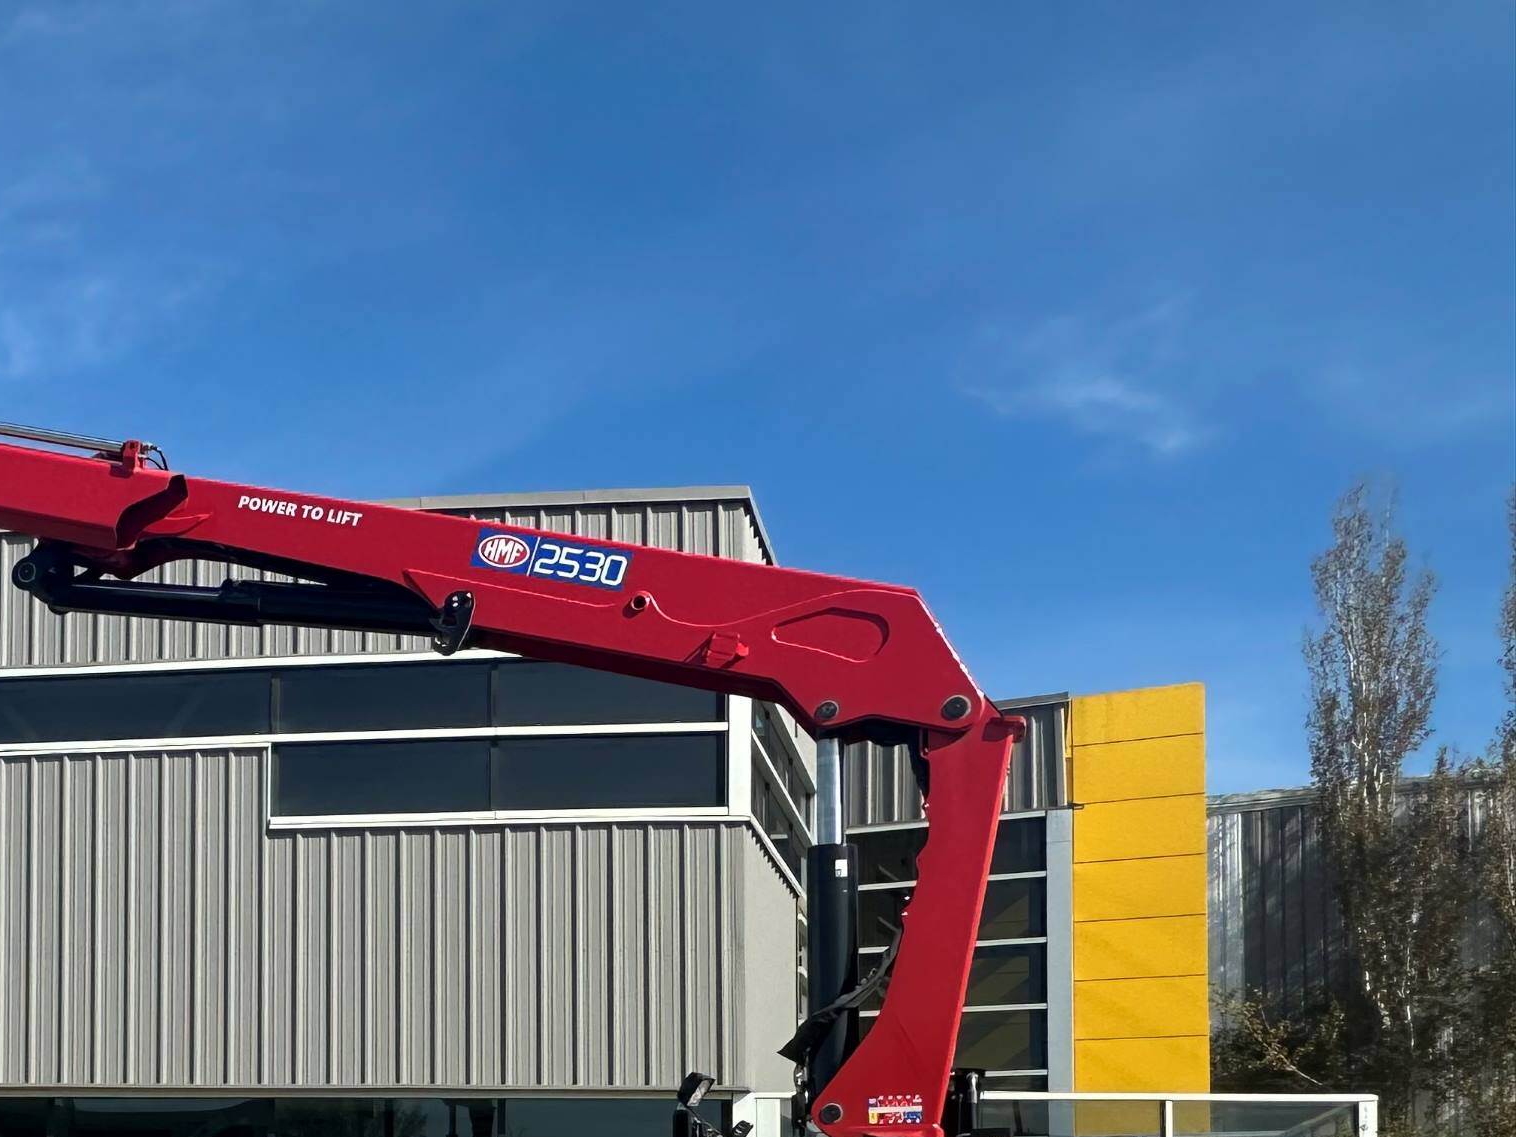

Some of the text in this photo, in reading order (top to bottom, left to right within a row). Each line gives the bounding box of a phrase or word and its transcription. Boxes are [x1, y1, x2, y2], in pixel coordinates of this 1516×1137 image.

[238, 495, 363, 526] POWER TO LIFT
[485, 538, 628, 586] HMF 2530
